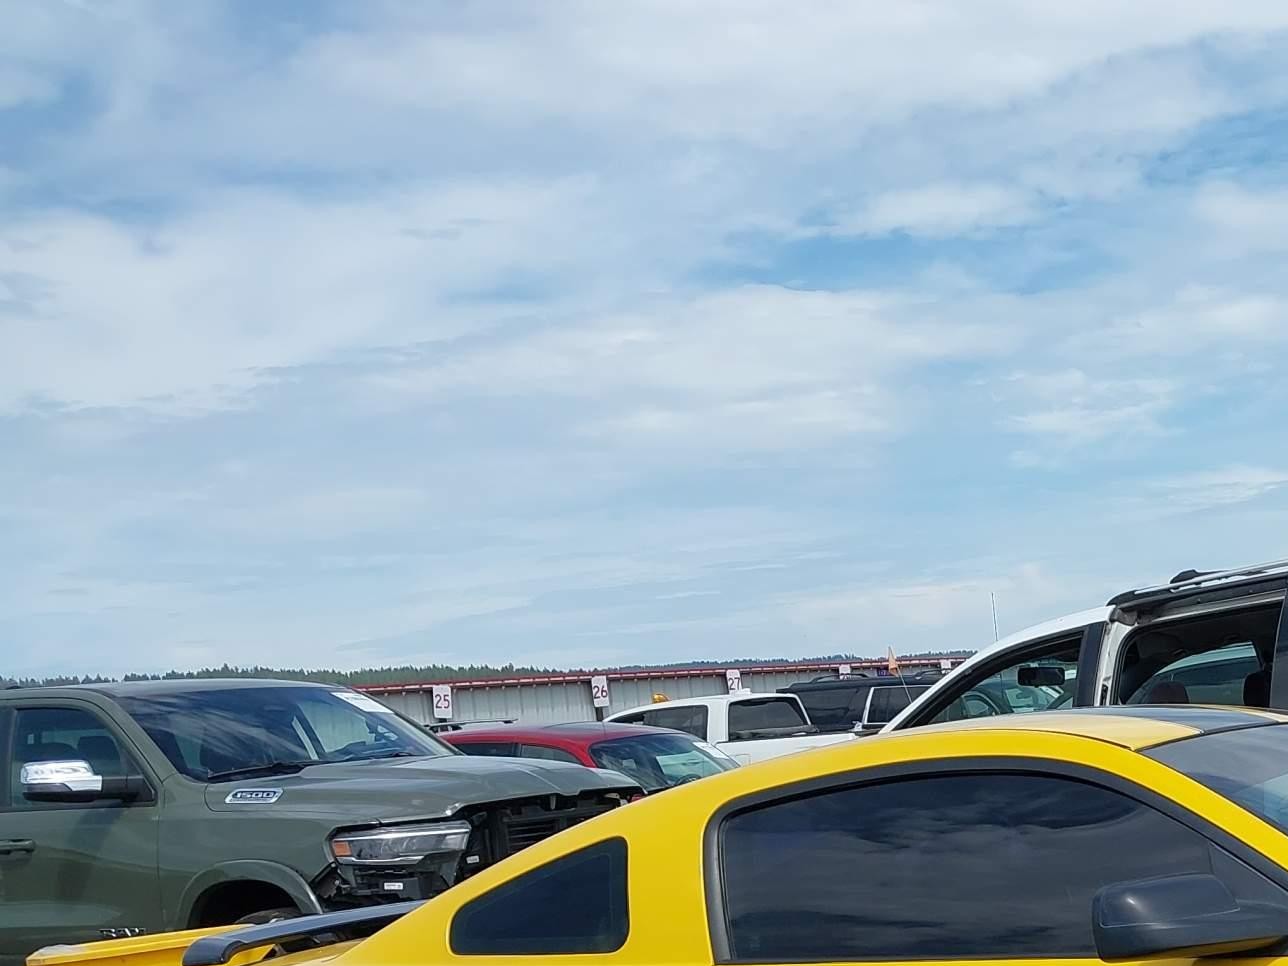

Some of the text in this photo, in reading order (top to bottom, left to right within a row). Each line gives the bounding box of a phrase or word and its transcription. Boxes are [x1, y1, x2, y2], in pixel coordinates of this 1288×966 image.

[728, 677, 740, 690] 27
[592, 685, 608, 699] 26
[435, 694, 450, 709] 25
